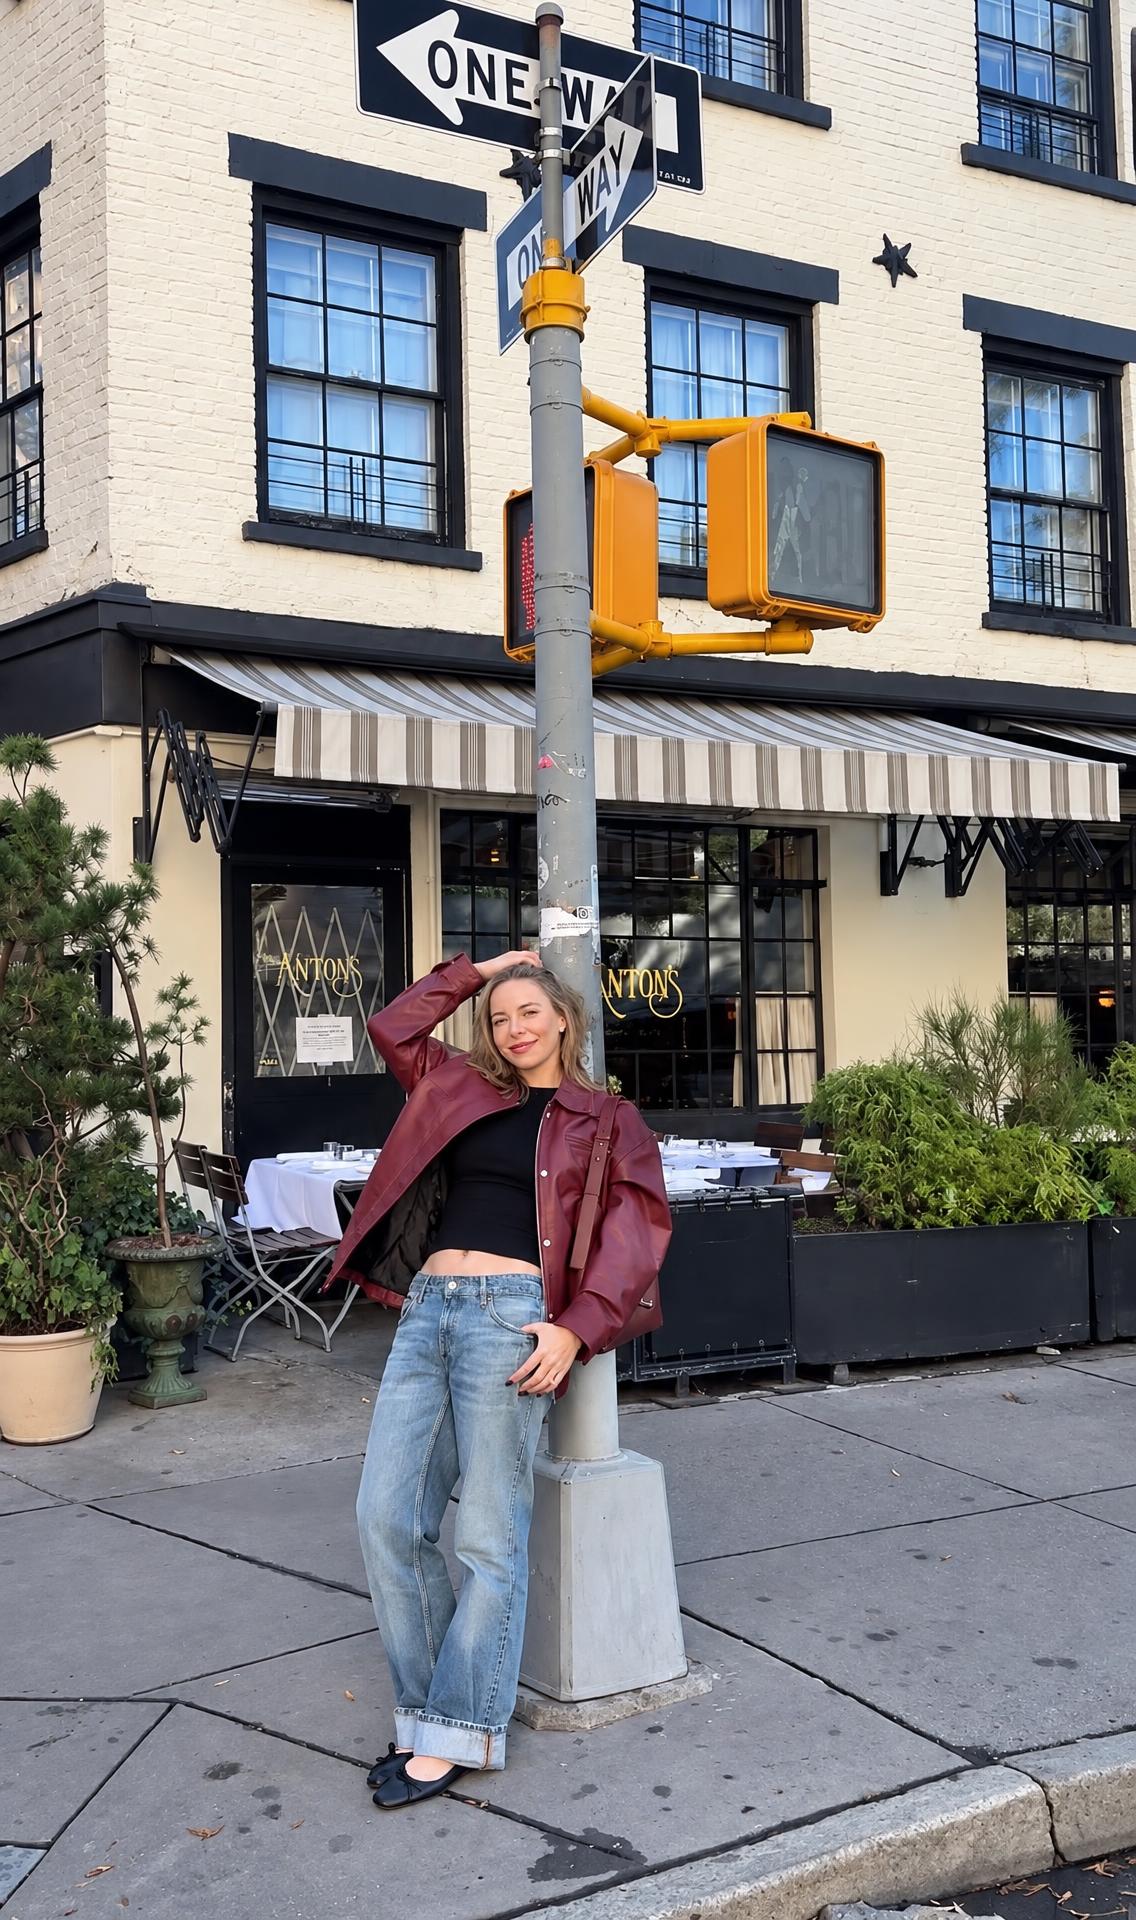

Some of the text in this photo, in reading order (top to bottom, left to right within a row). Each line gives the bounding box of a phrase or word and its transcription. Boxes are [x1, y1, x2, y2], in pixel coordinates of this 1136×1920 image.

[427, 39, 532, 110] ONE
[518, 130, 626, 290] ON WAY
